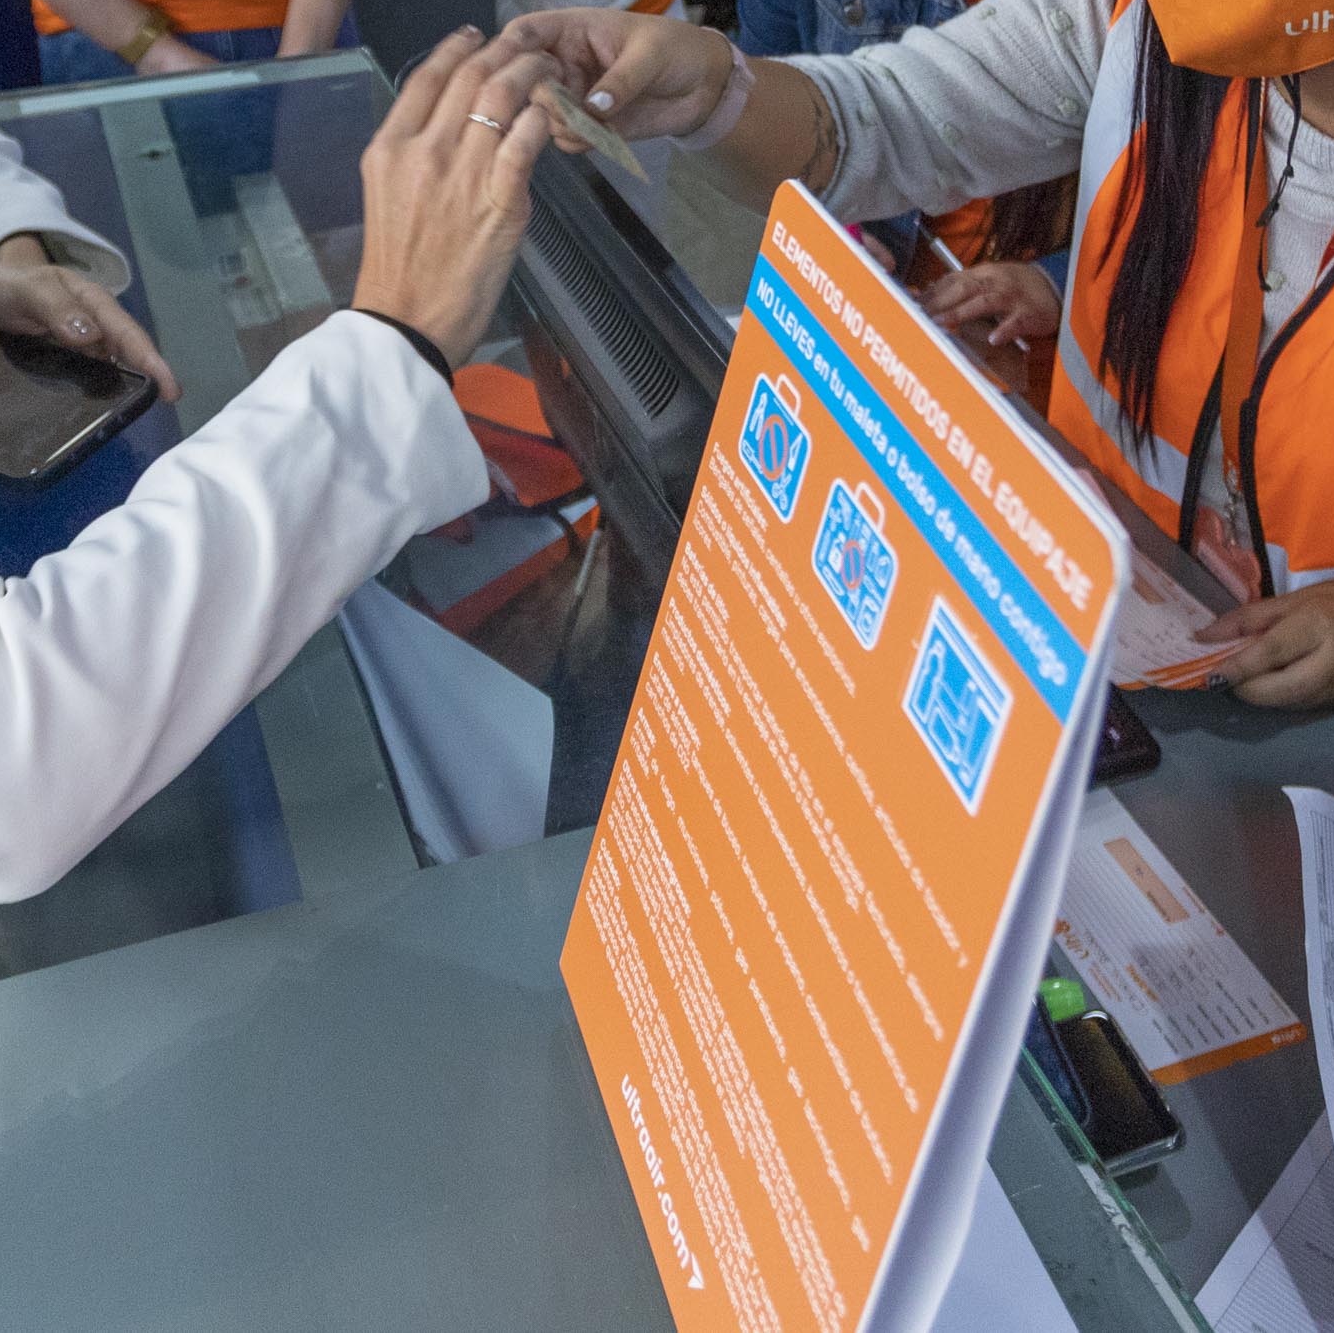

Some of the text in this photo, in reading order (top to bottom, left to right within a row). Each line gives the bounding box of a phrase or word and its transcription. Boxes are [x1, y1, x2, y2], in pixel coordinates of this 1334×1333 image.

[755, 274, 1070, 700] NO LLEVES en tu maleta o bolso de mano contigo
[771, 218, 1093, 614] ELEMENTOS NO PERMITIDOS EN EL EQUIPAJE
[621, 1073, 691, 1270] ultraair.com
